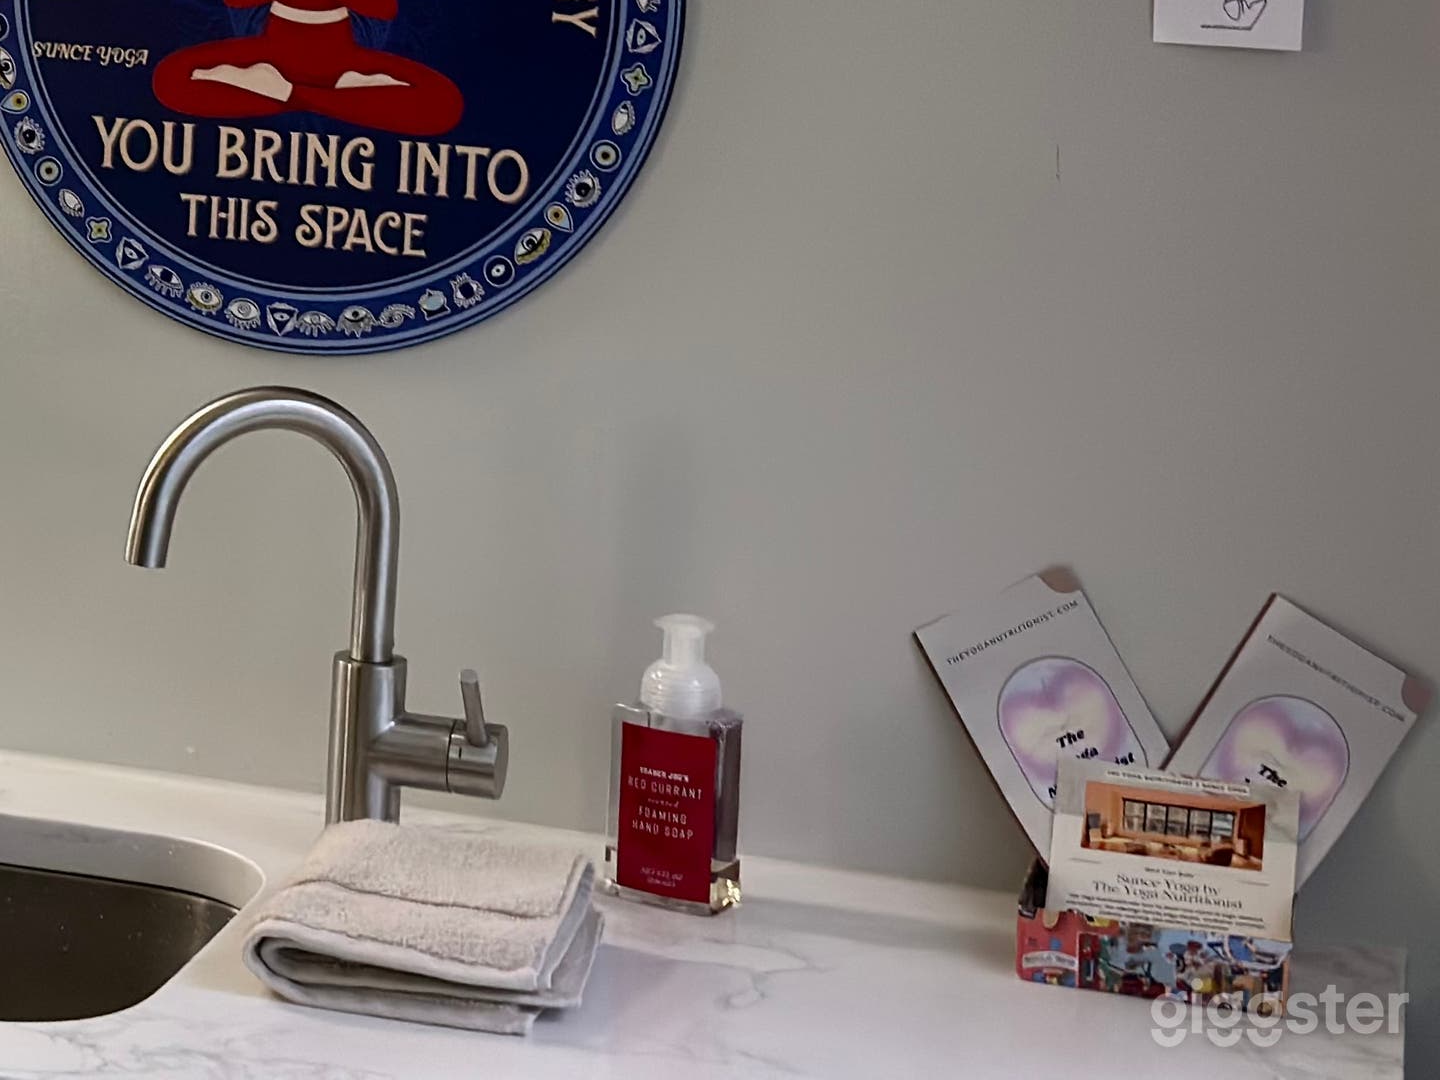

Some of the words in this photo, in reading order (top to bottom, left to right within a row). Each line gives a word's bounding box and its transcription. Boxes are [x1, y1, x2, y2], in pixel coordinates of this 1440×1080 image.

[33, 41, 94, 62] SUNCE
[96, 46, 150, 68] YOGA
[91, 115, 195, 177] YOU
[216, 126, 375, 192] BRING
[398, 139, 530, 206] INTO
[180, 192, 278, 242] THIS
[297, 205, 428, 258] SPACE
[1056, 730, 1085, 748] The
[1258, 763, 1288, 789] The
[651, 781, 702, 801] CURRANT
[638, 805, 688, 825] FOAMING
[632, 819, 659, 836] HAND
[664, 826, 694, 840] SOAP
